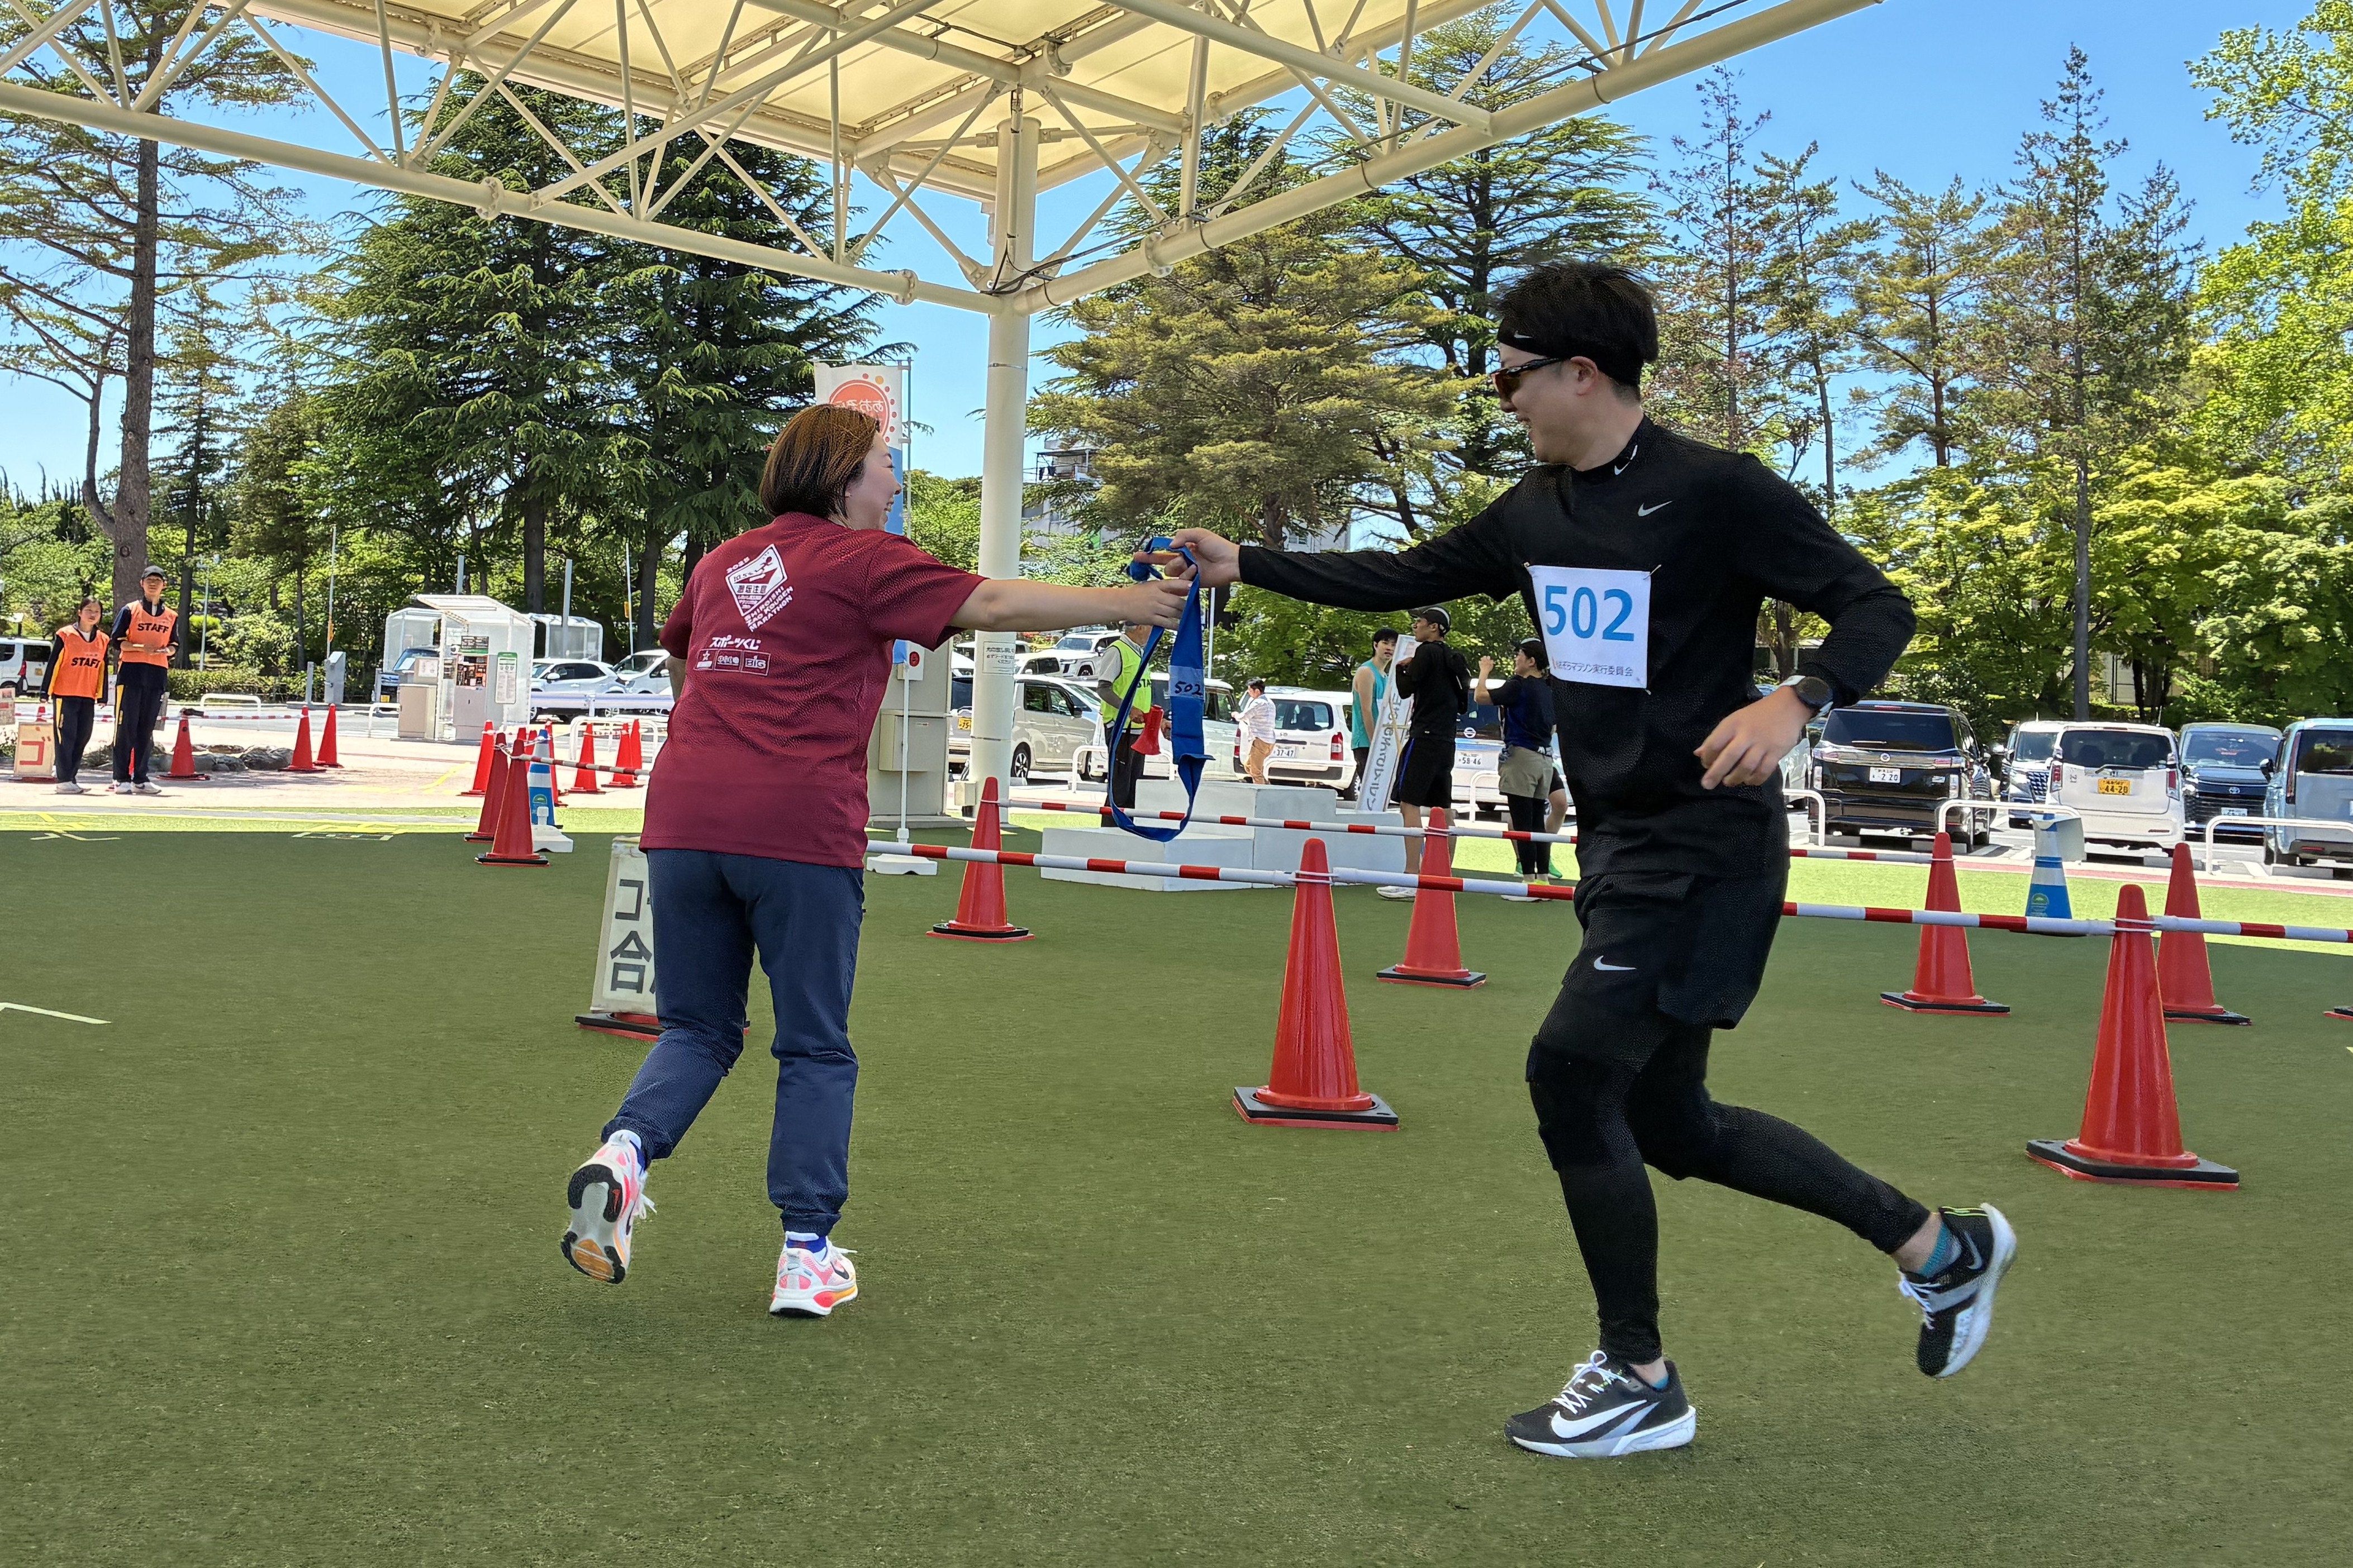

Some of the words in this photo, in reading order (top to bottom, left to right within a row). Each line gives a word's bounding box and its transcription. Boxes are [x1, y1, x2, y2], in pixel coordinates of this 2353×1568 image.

[744, 586, 784, 621] SHIROISHI
[746, 613, 763, 627] ZAO
[749, 595, 793, 632] MARATHON
[1546, 585, 1634, 641] 502
[137, 623, 169, 633] STAFF
[710, 635, 761, 650] スポーツくじ
[745, 655, 766, 669] BIG
[1175, 681, 1204, 696] 502
[19, 736, 51, 766] ゴ
